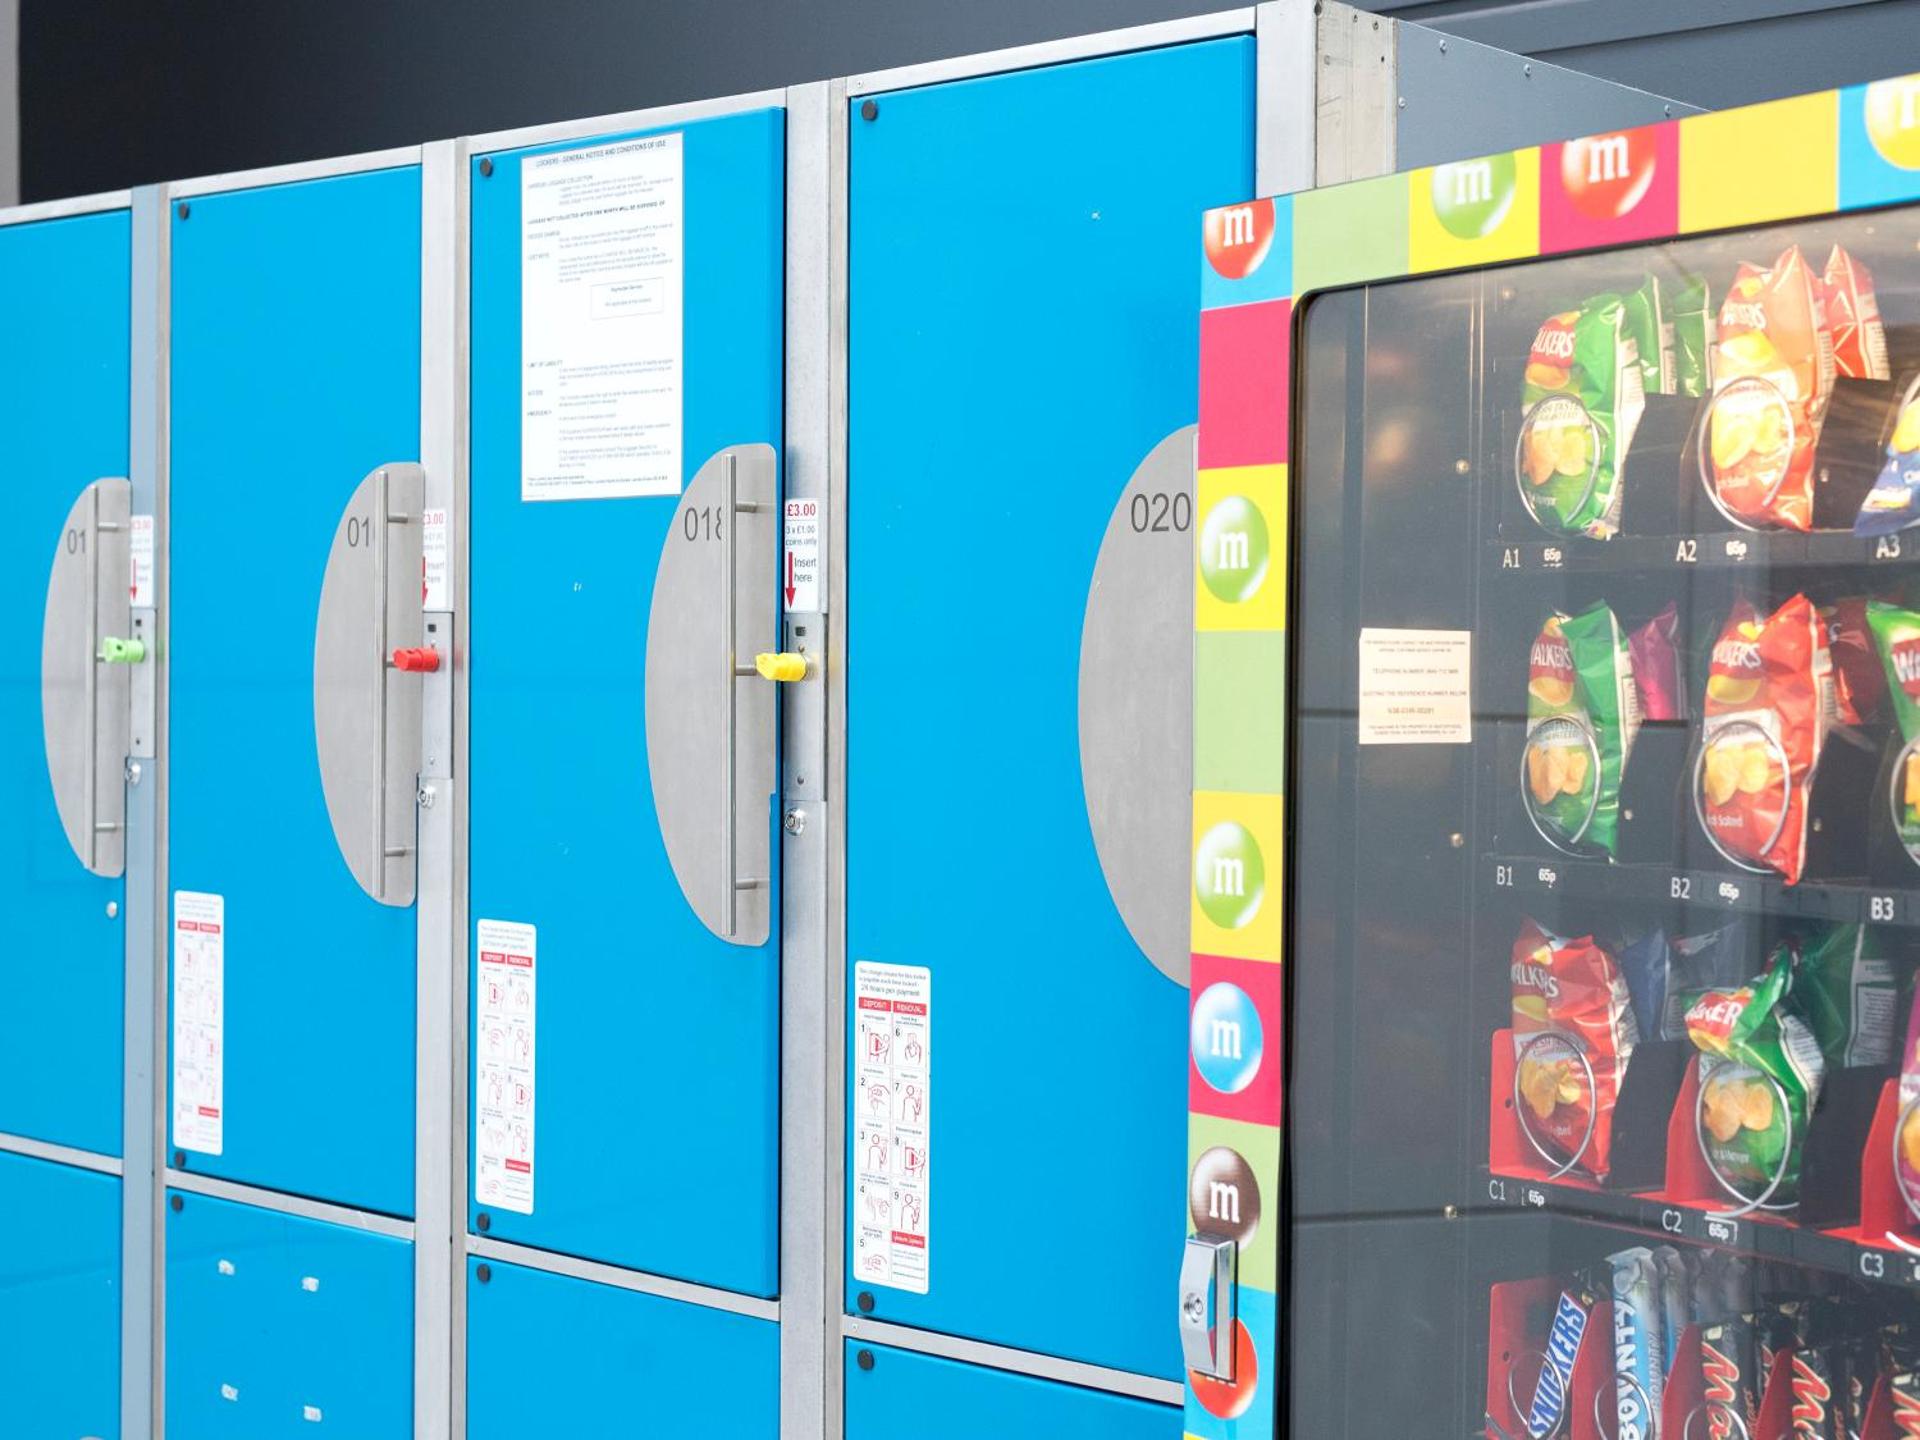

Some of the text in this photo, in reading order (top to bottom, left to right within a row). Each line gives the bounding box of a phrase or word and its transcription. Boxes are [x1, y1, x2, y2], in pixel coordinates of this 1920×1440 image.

[586, 149, 605, 159] NOTICE
[605, 147, 617, 156] AND
[617, 142, 647, 154] CONDITIONS
[1588, 135, 1631, 184] m
[1455, 159, 1494, 205] m
[1222, 205, 1254, 247] m
[1530, 326, 1576, 359] ALKERS
[787, 504, 816, 517] £3.00
[1131, 492, 1191, 533] 020
[67, 529, 86, 554] 01
[347, 517, 375, 547] 01
[1219, 531, 1249, 569] m
[1503, 548, 1562, 568] A1 65p
[1676, 540, 1697, 562] A2
[1876, 536, 1901, 559] A3
[794, 557, 817, 568] Insert
[794, 572, 812, 582] here
[1213, 857, 1245, 896] m
[1496, 866, 1556, 886] B1 65p
[1671, 877, 1740, 901] B2 65p
[1871, 897, 1894, 920] B3
[863, 1000, 886, 1008] DEPOSIT
[895, 1027, 901, 1037] 6
[1211, 1019, 1242, 1060] m
[861, 1077, 866, 1086] 2
[1209, 1181, 1240, 1224] m
[1489, 1180, 1545, 1207] C1 65p
[1662, 1209, 1729, 1241] C2 65p
[859, 1238, 865, 1247] 5
[1860, 1252, 1884, 1278] C3
[1529, 1293, 1586, 1438] SNICKERS
[1614, 1299, 1641, 1440] BOUNTY
